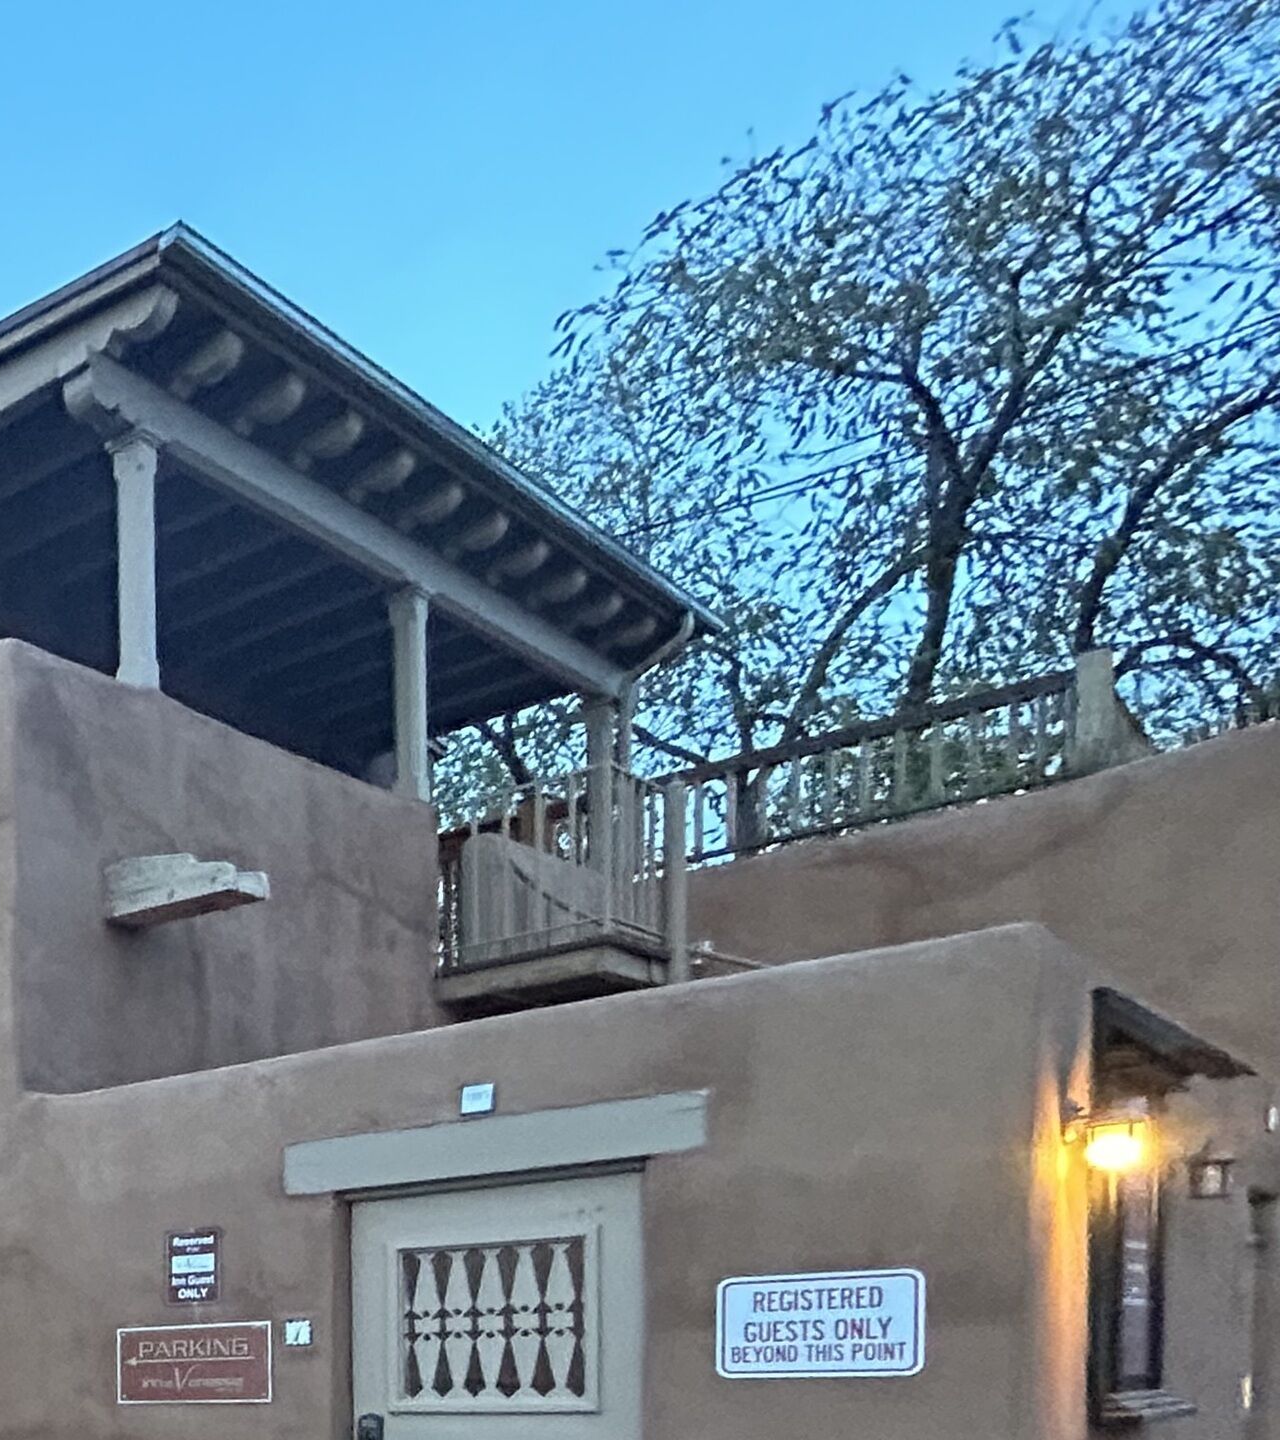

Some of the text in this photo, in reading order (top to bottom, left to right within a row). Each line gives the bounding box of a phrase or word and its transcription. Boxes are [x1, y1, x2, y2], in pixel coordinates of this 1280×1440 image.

[177, 1287, 209, 1300] ONLY
[752, 1285, 884, 1313] REGISTERED
[743, 1316, 893, 1343] GUESTS ONLY
[138, 1337, 249, 1359] PARKING
[730, 1341, 907, 1364] BEYOND THIS POINT
